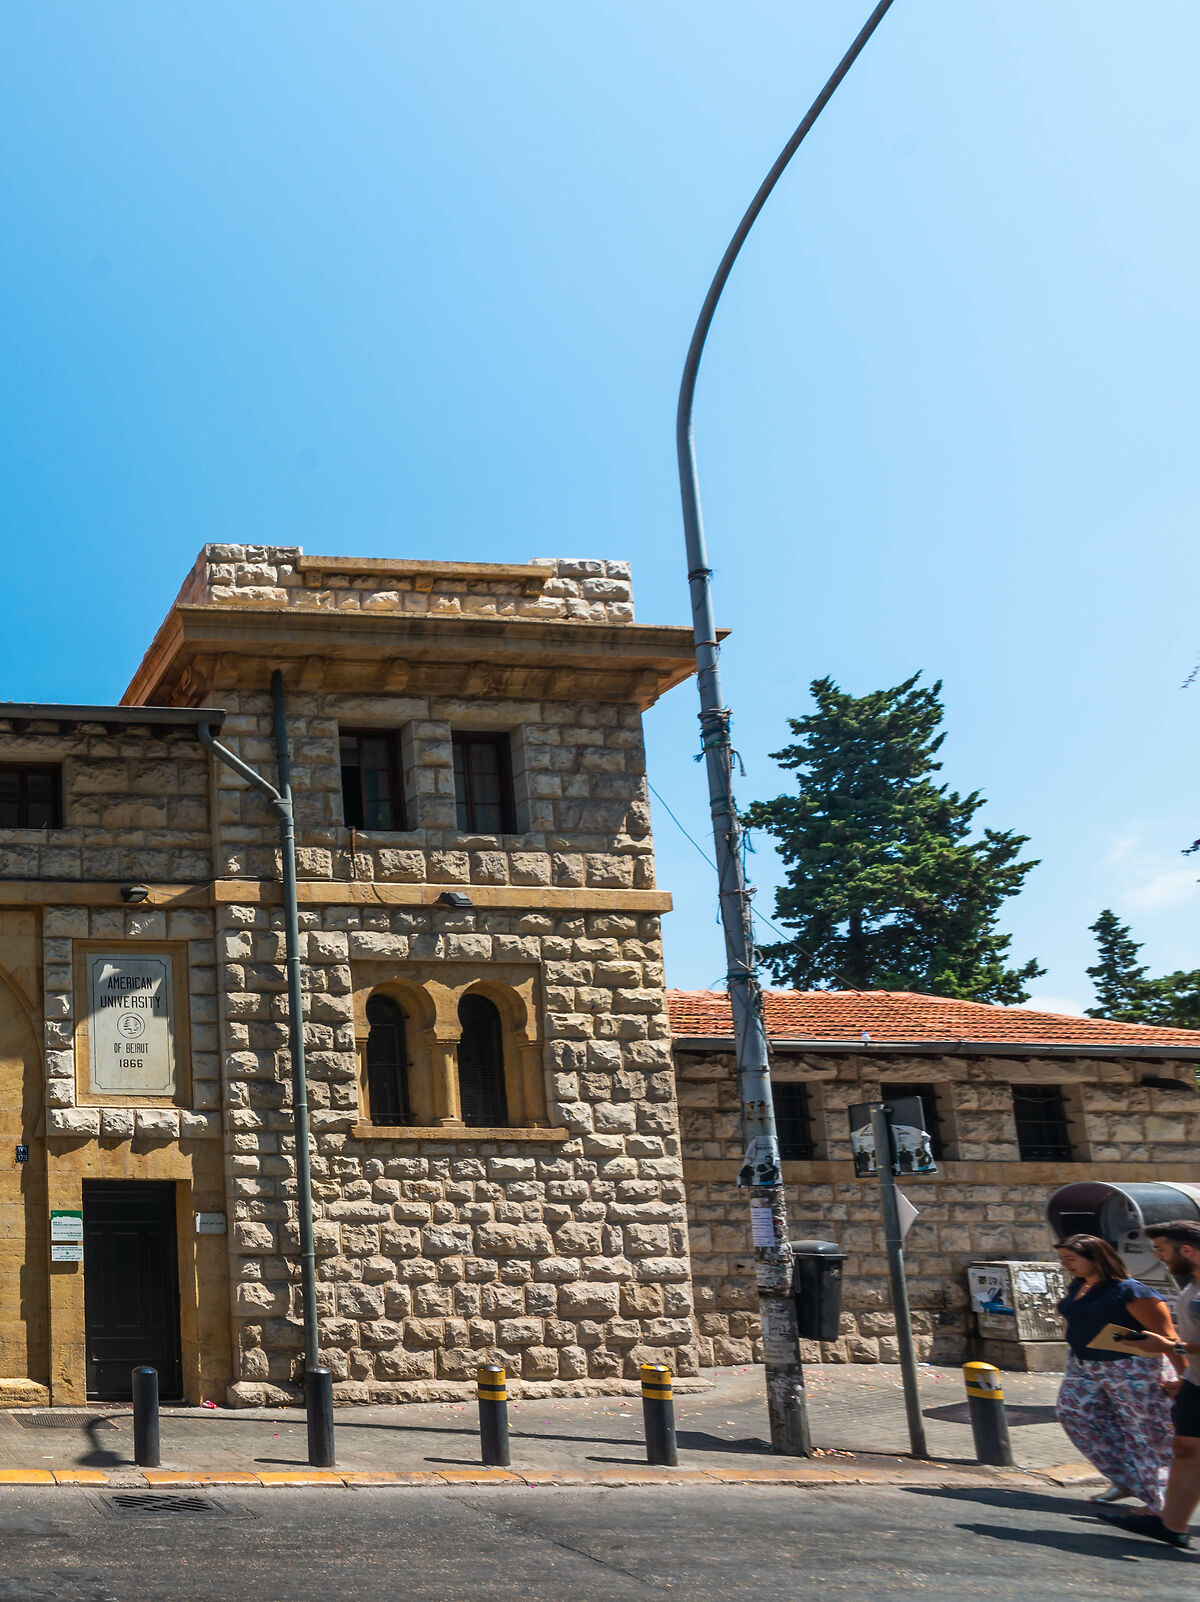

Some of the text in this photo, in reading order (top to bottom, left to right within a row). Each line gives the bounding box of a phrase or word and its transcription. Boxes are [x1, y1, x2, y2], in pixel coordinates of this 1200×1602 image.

[107, 976, 153, 990] AMERICAN
[100, 995, 161, 1009] UNIVERSITY
[113, 1042, 149, 1054] OF BEIRUT
[119, 1059, 143, 1068] 1866
